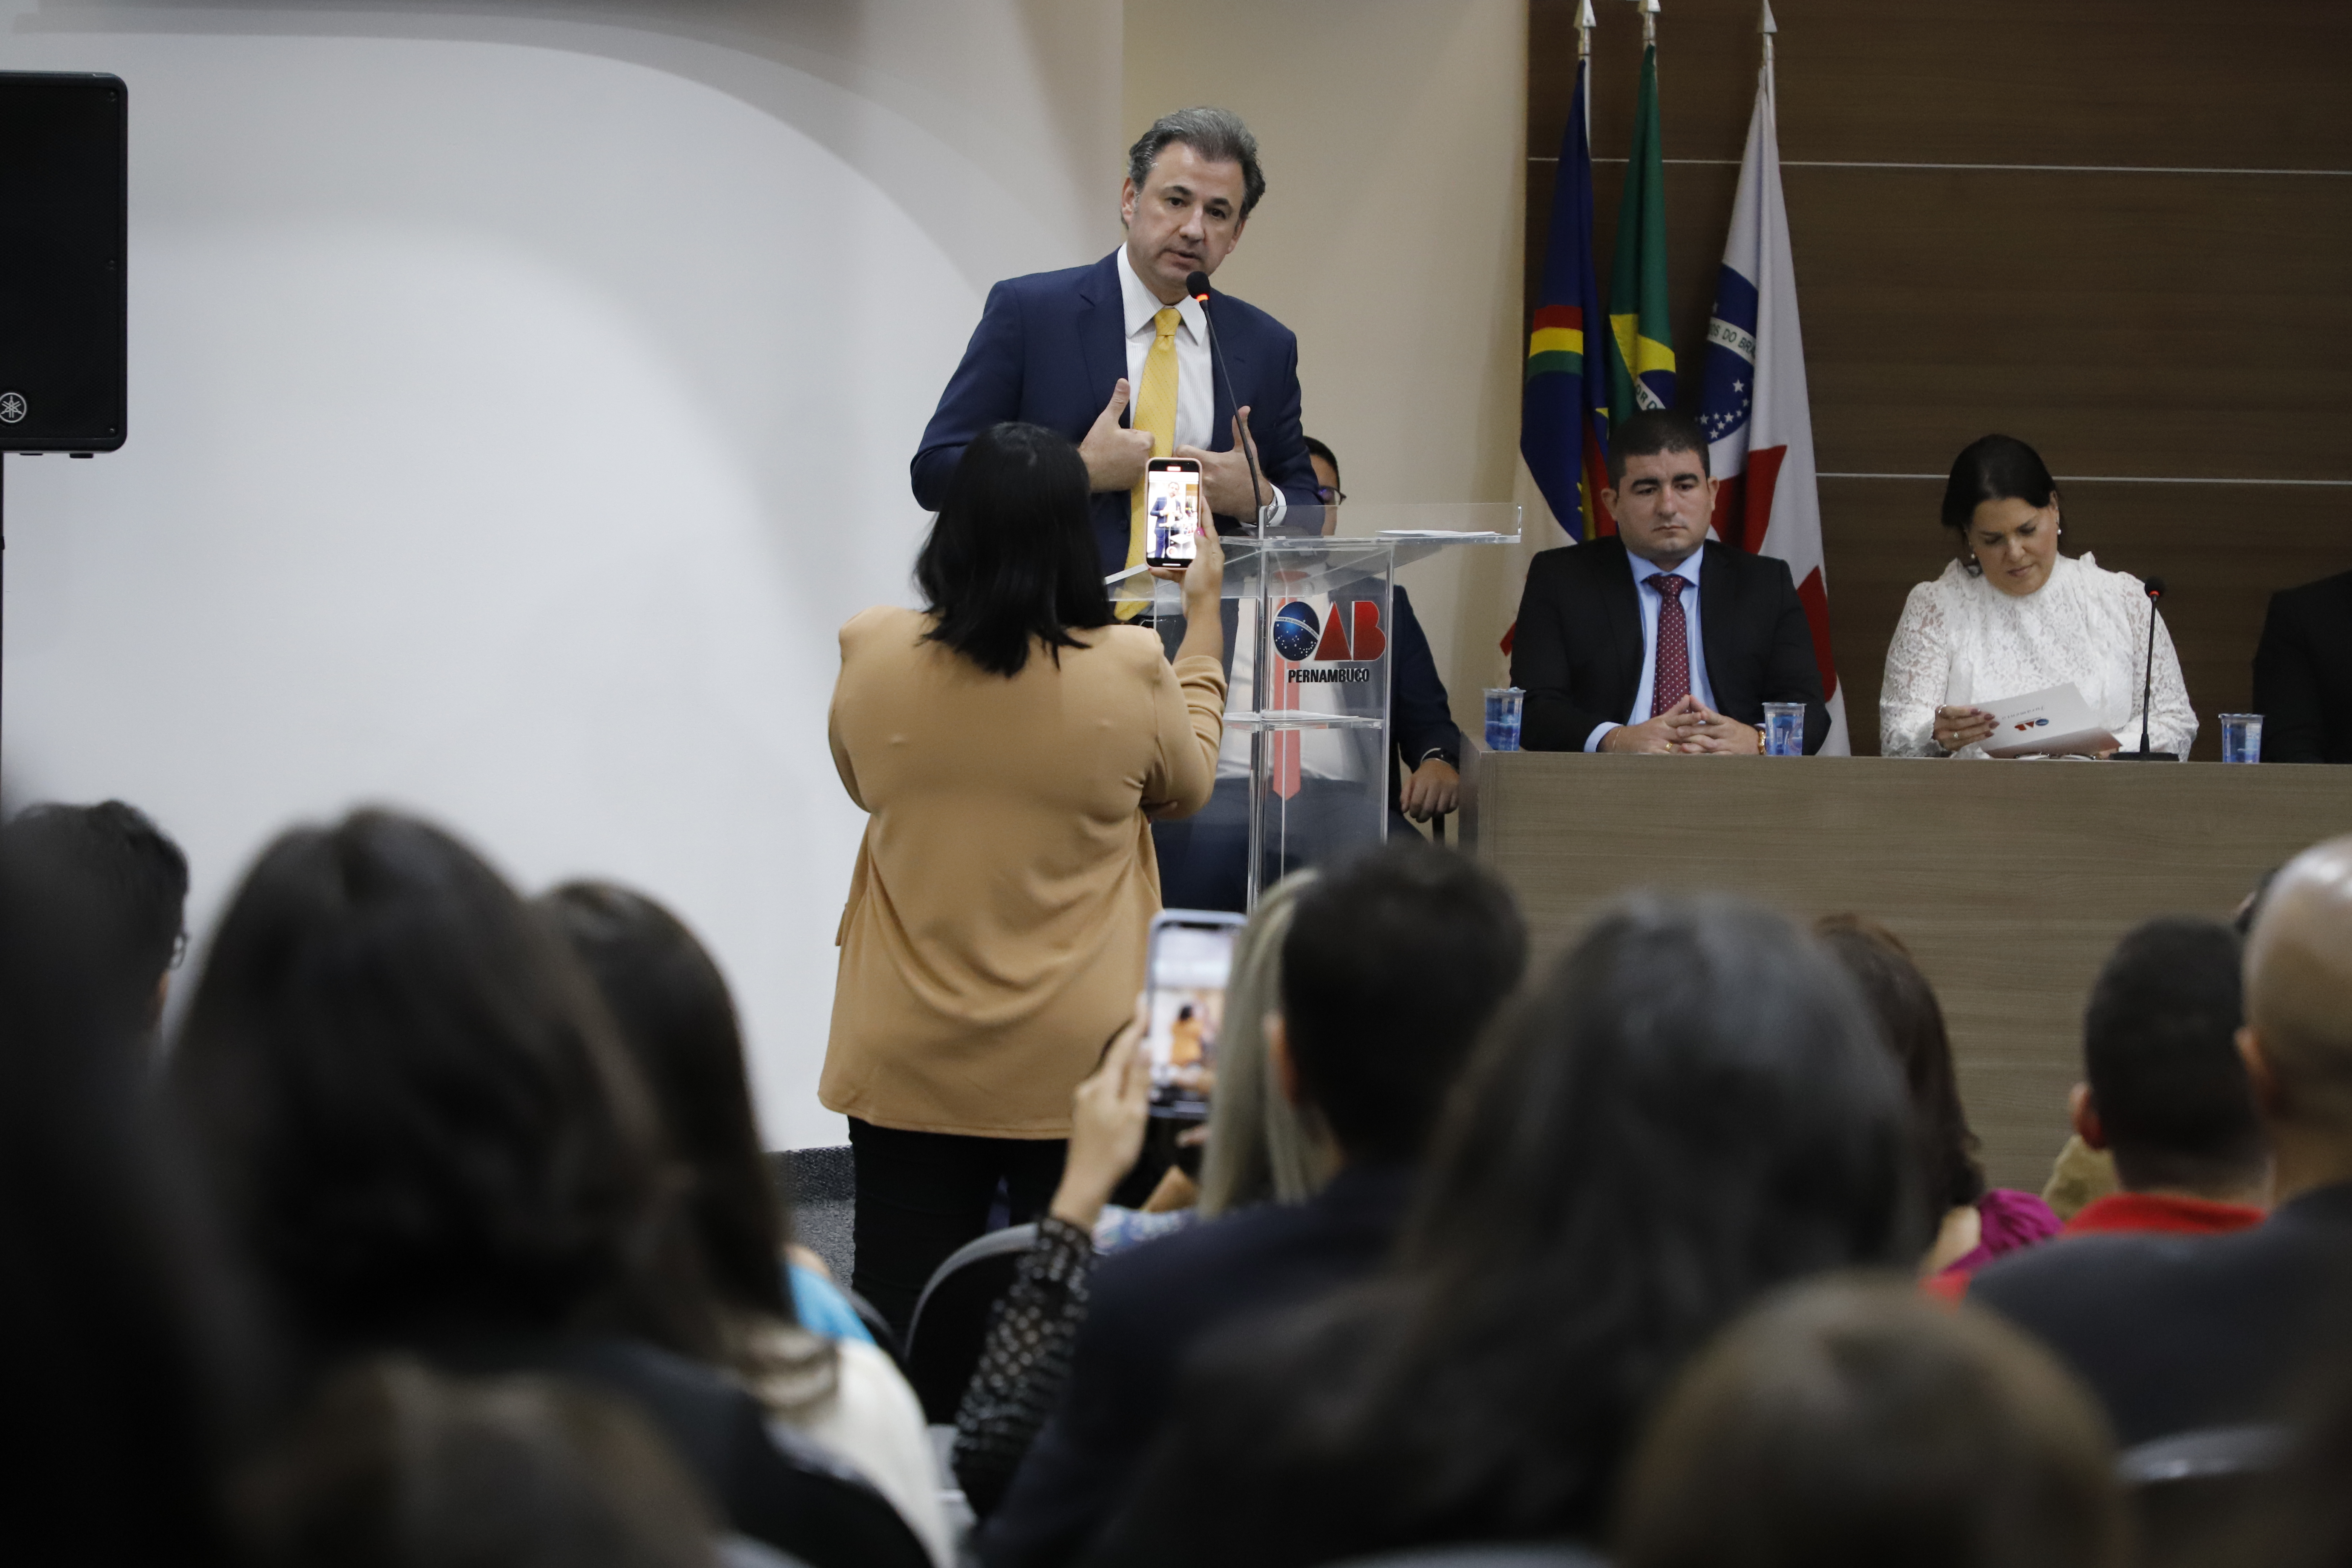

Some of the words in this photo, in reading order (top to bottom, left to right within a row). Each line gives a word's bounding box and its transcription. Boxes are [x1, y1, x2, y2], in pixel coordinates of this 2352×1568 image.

[1722, 328, 1737, 343] DO
[1272, 600, 1387, 662] OAB
[1288, 669, 1369, 683] PERNAMBUCO
